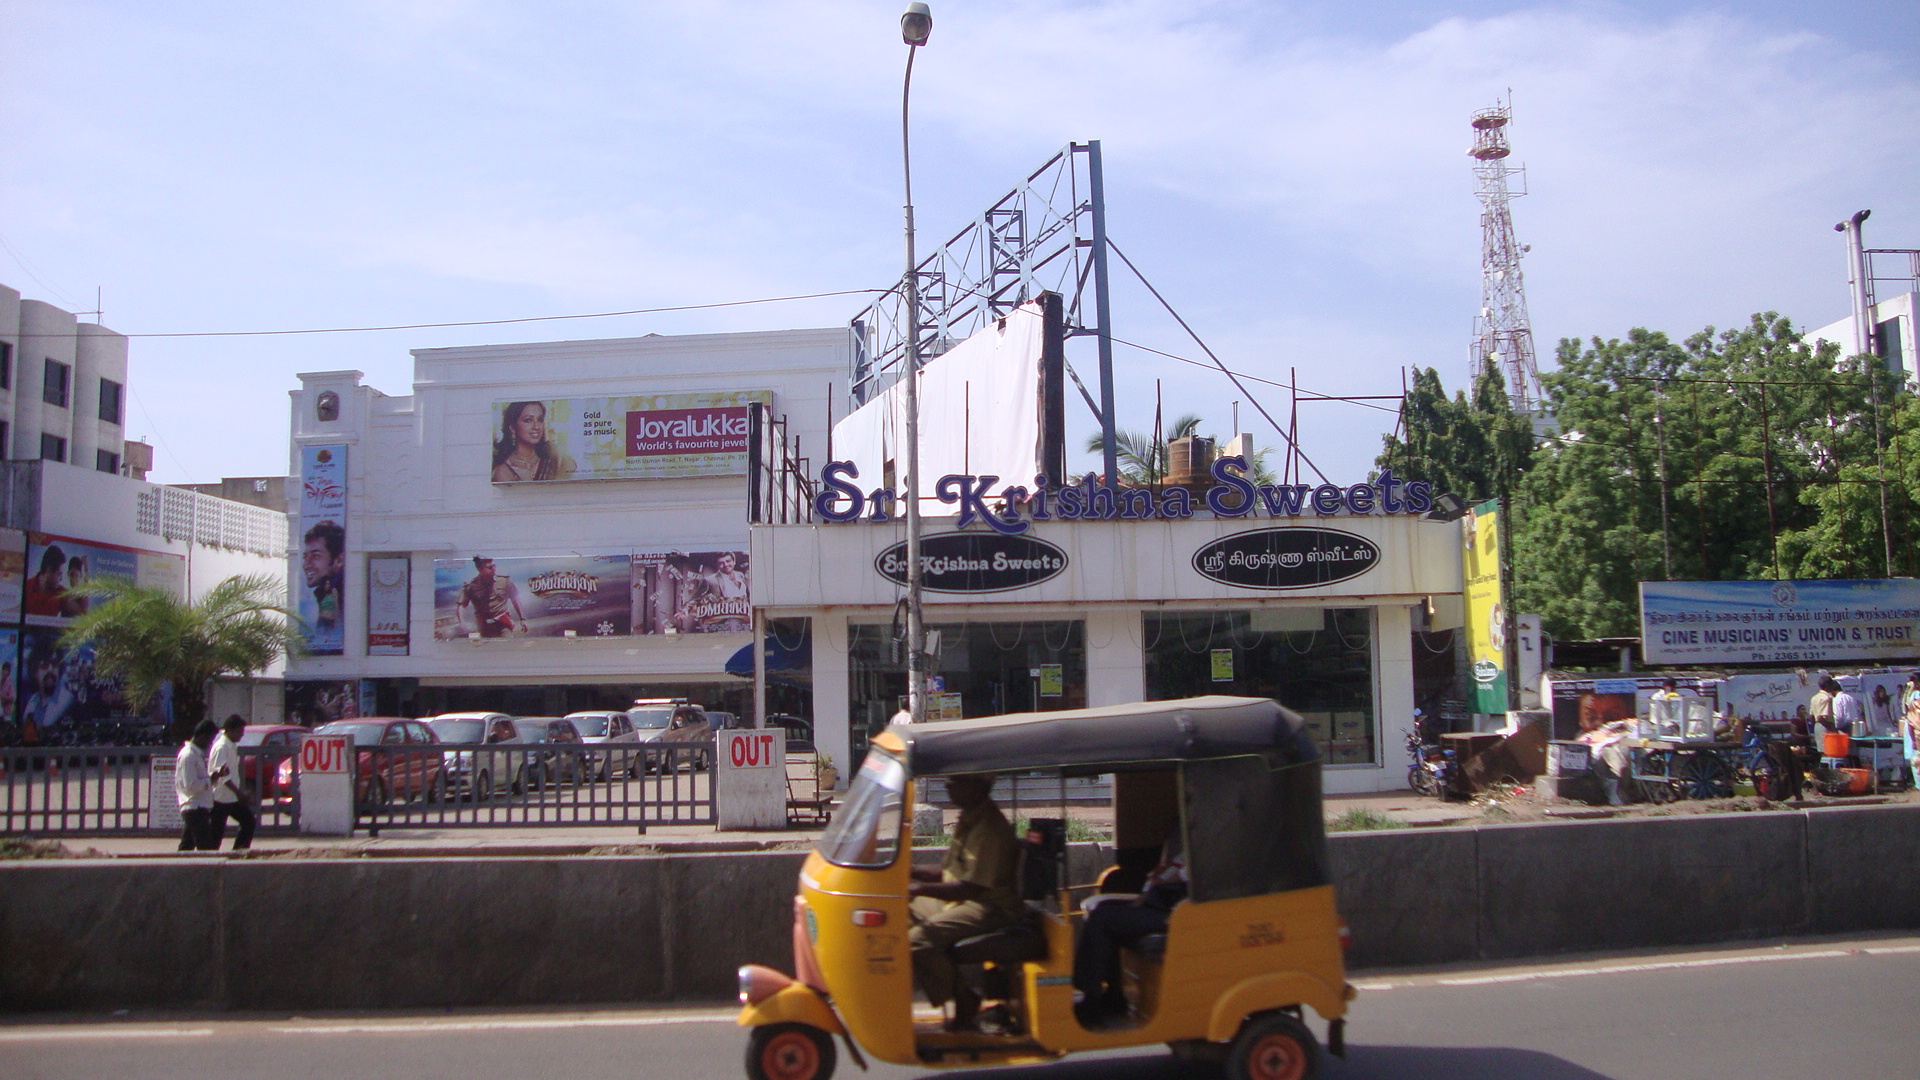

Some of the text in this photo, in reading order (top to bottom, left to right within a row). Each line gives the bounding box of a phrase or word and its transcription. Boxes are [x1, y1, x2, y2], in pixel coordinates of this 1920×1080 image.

[583, 411, 601, 420] Gold
[594, 420, 612, 429] pure
[594, 428, 616, 436] music
[636, 442, 673, 451] World's
[675, 439, 719, 450] favourite
[815, 454, 1432, 535] Sr Krishna Sweets
[883, 552, 1061, 575] Sr Krishna Sweets
[1662, 626, 1912, 644] CINE MUSICIANS' UNION & TRUST
[1751, 652, 1765, 661] Ph
[1774, 652, 1799, 660] 2365
[303, 739, 345, 771] OUT
[731, 735, 773, 767] OUT
